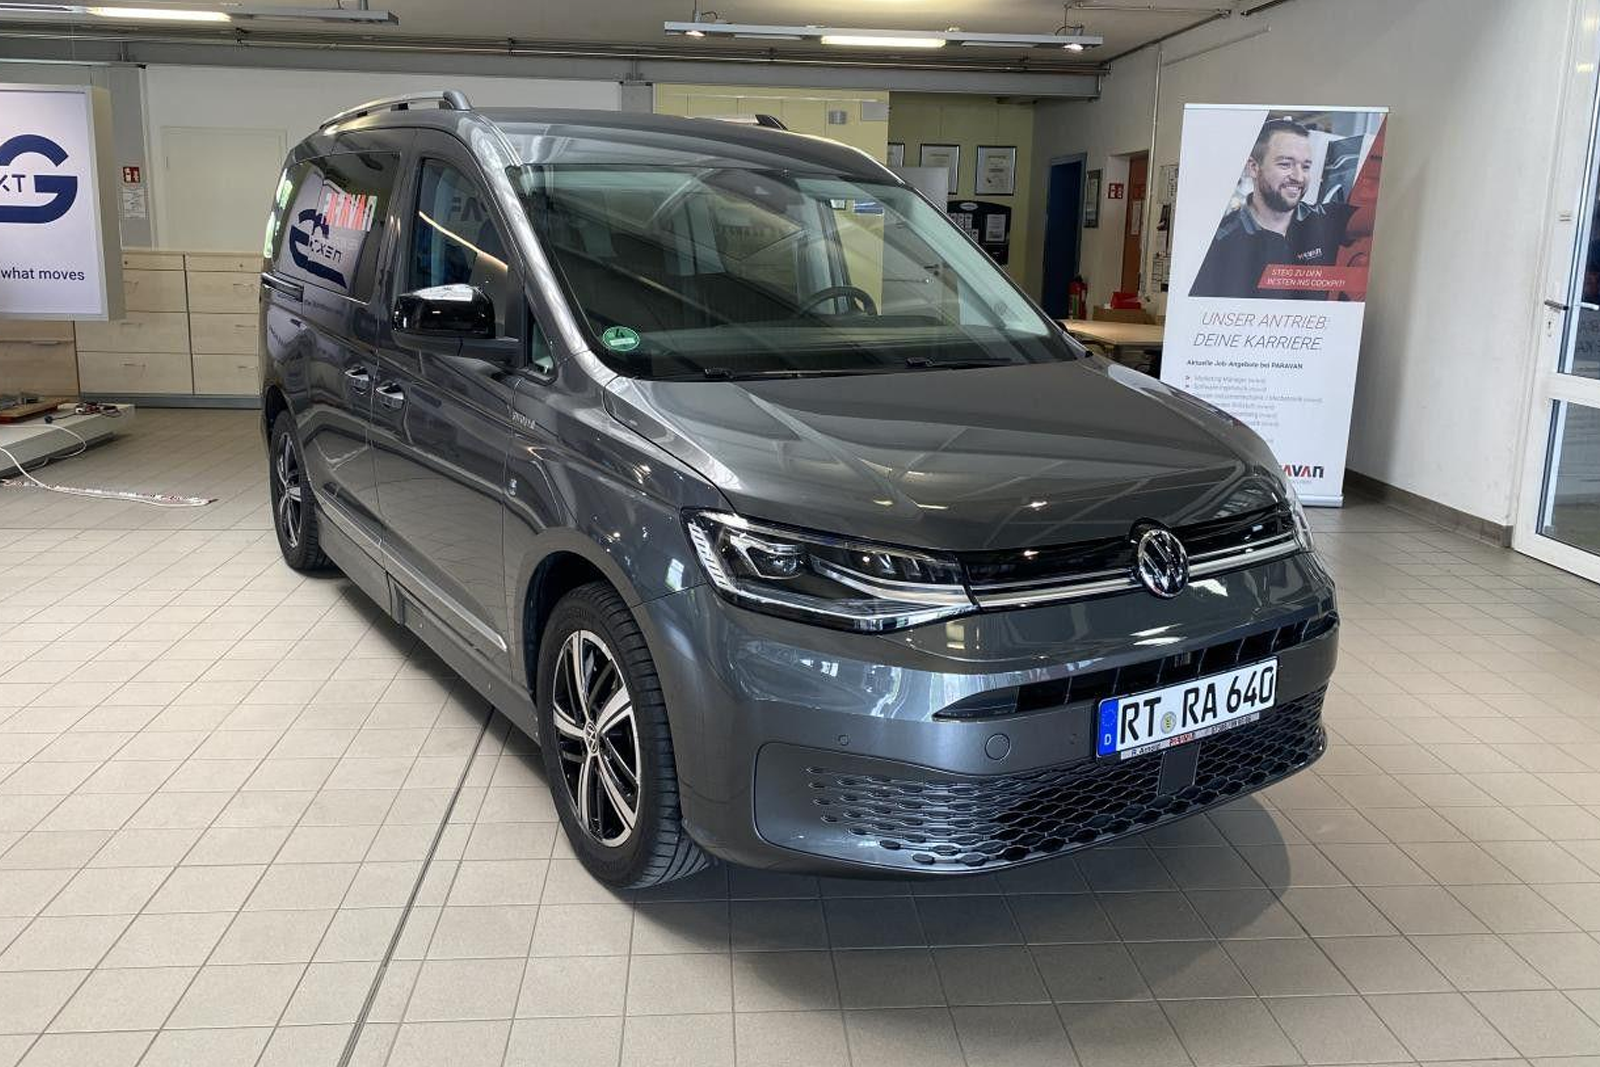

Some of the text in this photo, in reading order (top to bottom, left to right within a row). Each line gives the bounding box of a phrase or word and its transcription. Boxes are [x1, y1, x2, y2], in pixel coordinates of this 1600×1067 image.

[1, 267, 85, 281] what moves
[1202, 312, 1256, 327] UNSER
[1193, 333, 1323, 351] DEINE KARRIERE
[1271, 362, 1304, 370] PARAVAN
[1120, 697, 1161, 744] RT
[1181, 682, 1218, 728] RA
[1226, 666, 1274, 714] 640
[1104, 733, 1112, 746] D
